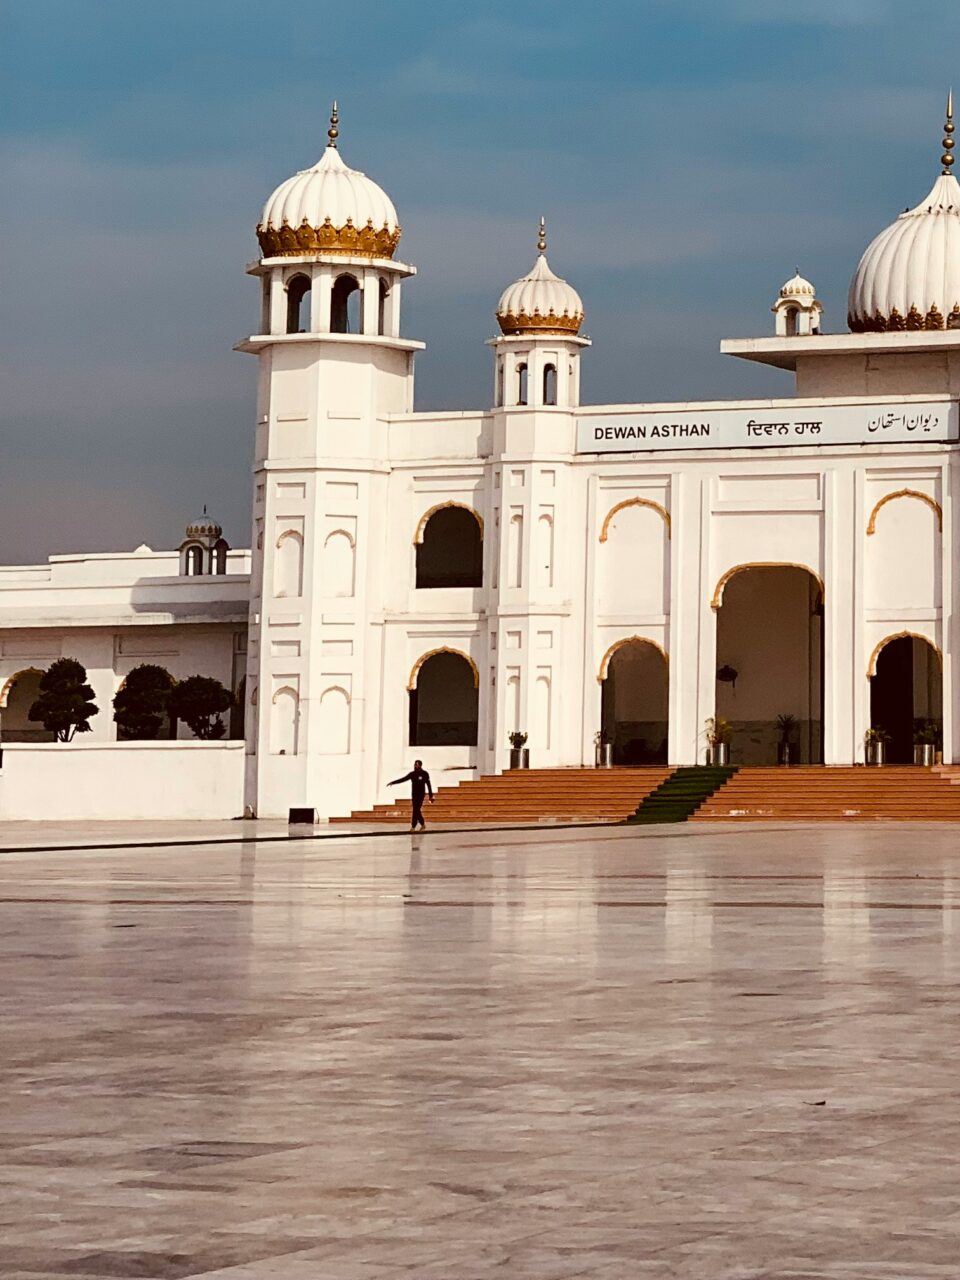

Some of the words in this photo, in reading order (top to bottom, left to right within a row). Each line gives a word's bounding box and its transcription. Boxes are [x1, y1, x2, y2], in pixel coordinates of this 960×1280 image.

[594, 426, 647, 440] DEWAN
[650, 423, 710, 438] ASTHAN
[746, 419, 790, 436] ਦਿਵਾਨ
[794, 421, 823, 435] ਹਾਲ
